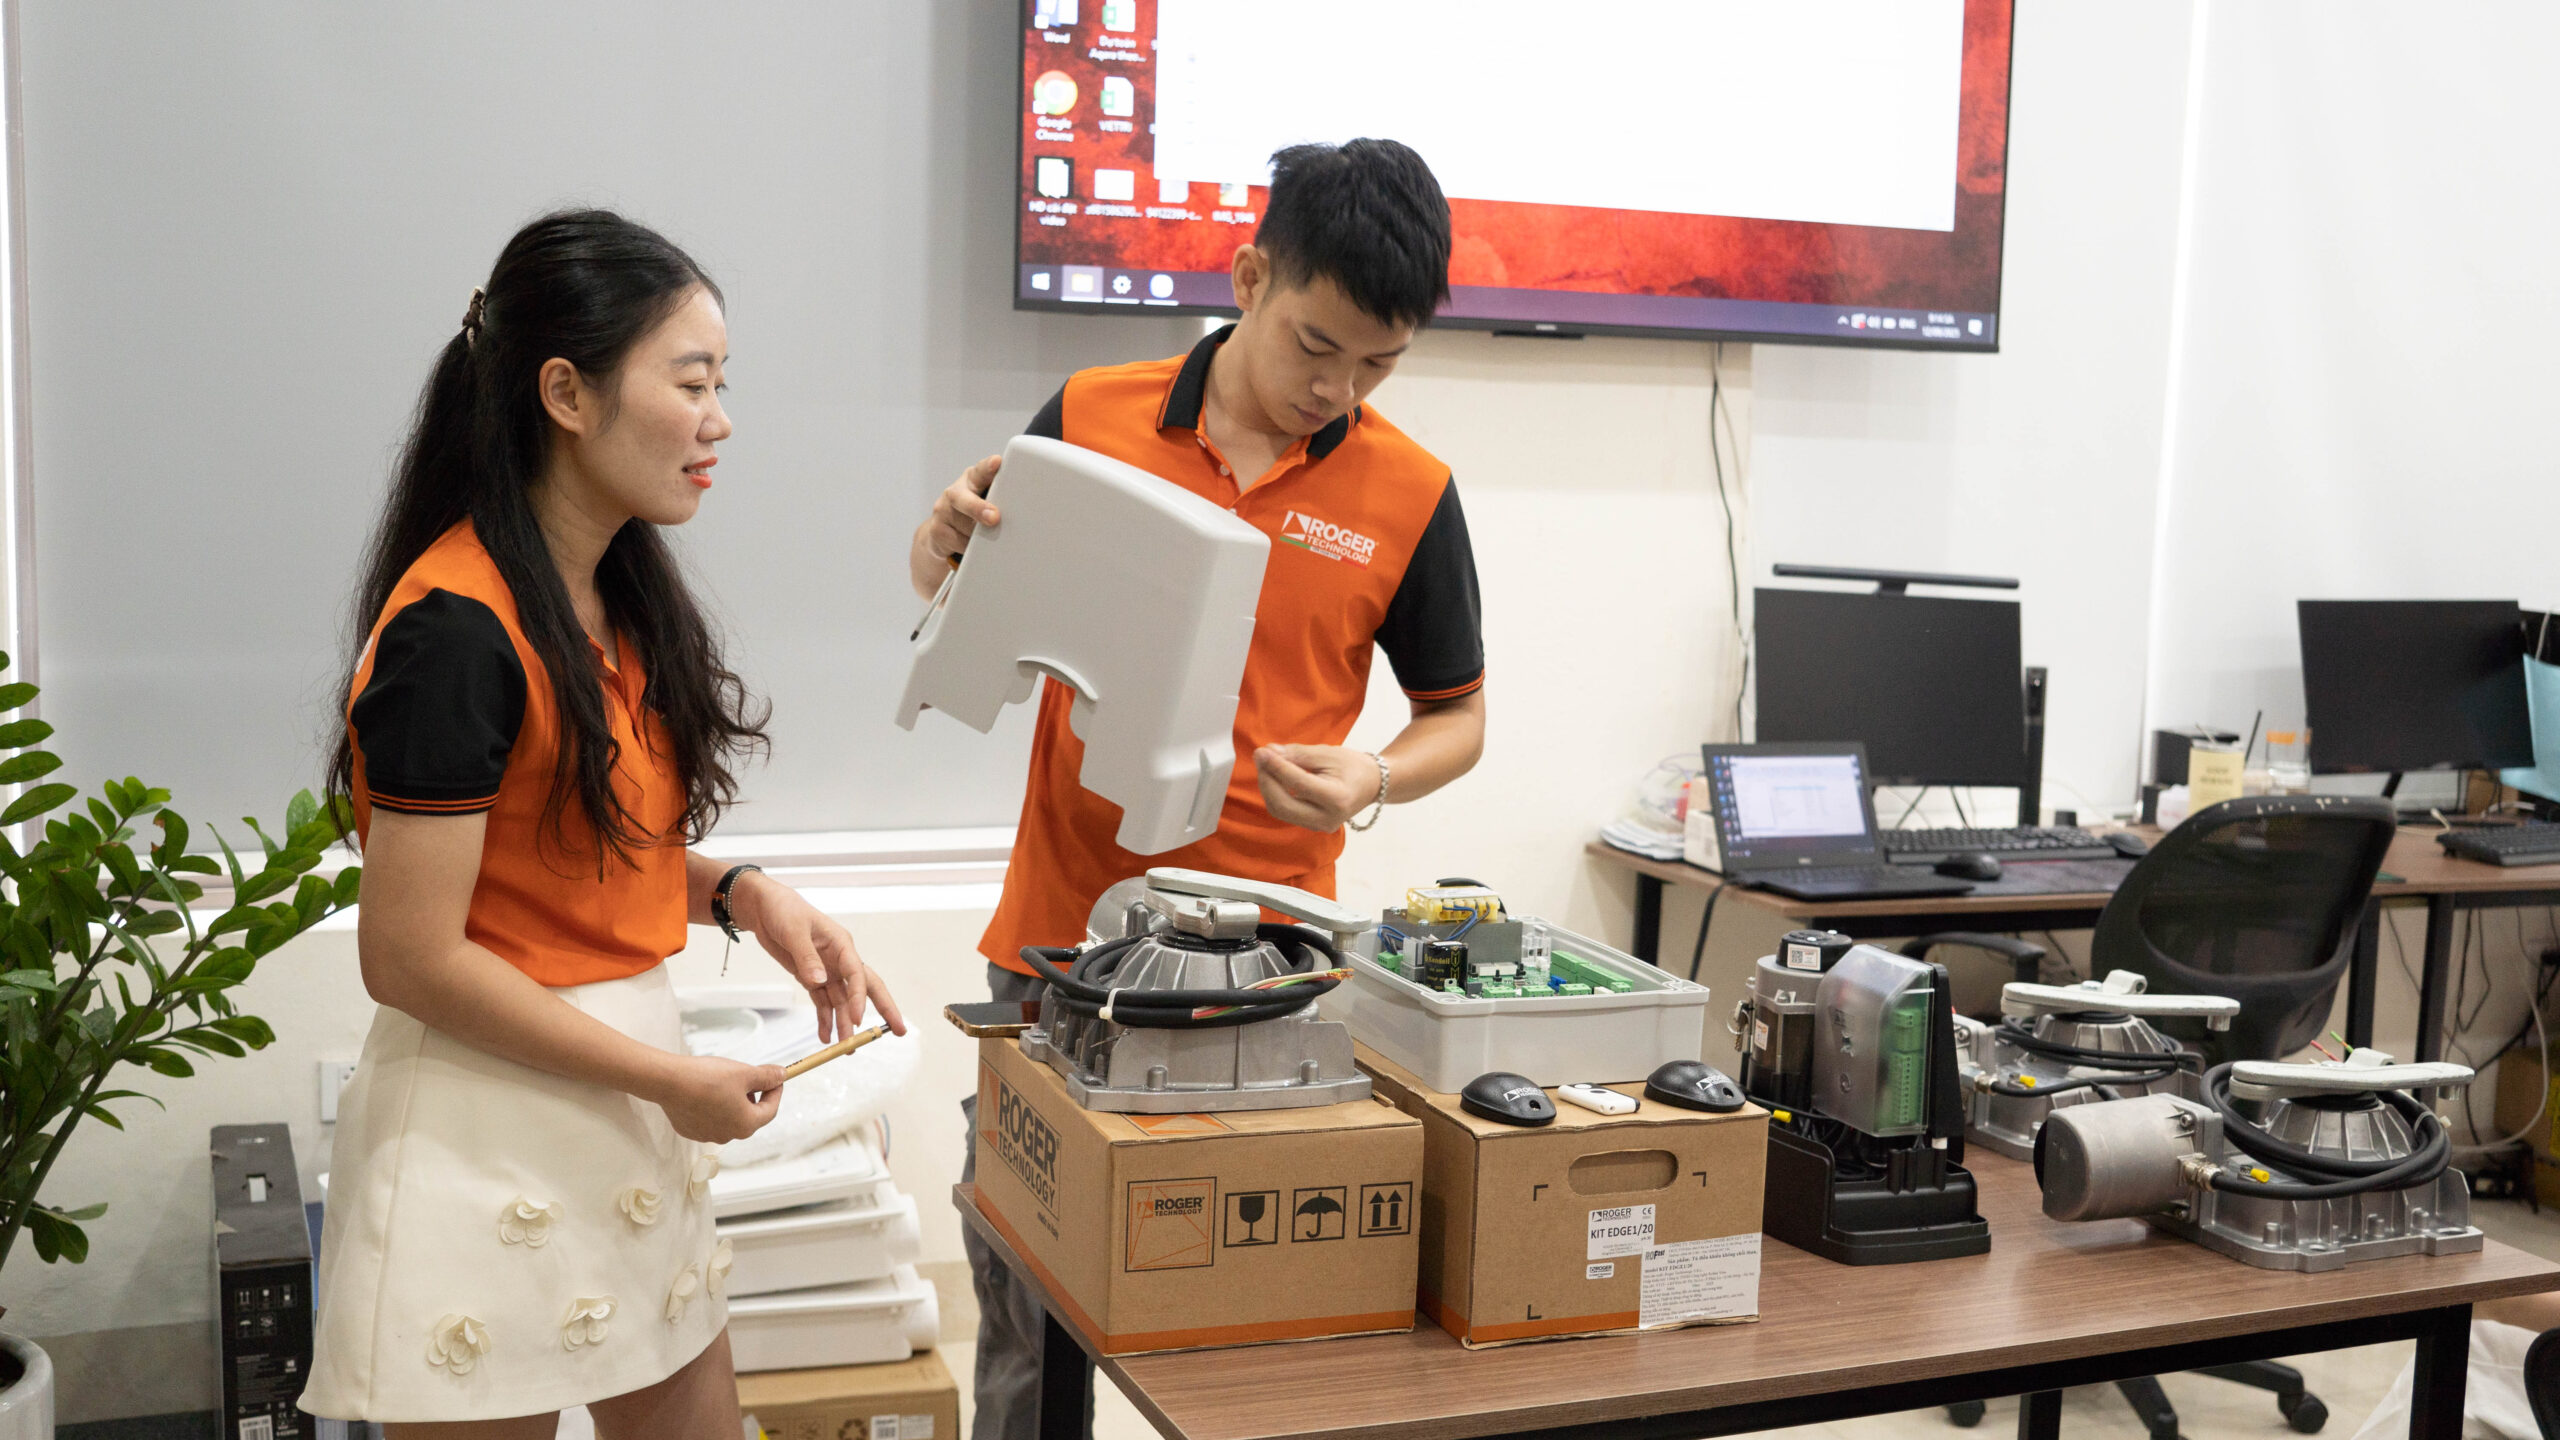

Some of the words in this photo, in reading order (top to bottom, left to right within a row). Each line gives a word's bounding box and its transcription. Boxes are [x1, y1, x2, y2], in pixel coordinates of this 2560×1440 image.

[1306, 535, 1371, 565] TECHNOLOGY
[1309, 518, 1375, 557] ROGER
[999, 1081, 1056, 1183] ROGER
[998, 1131, 1055, 1209] TECHNOLOGY
[1155, 1197, 1202, 1210] ROGER
[1603, 1208, 1632, 1218] ROGER
[1591, 1229, 1605, 1239] KIT
[1608, 1223, 1653, 1238] EDGE1/20
